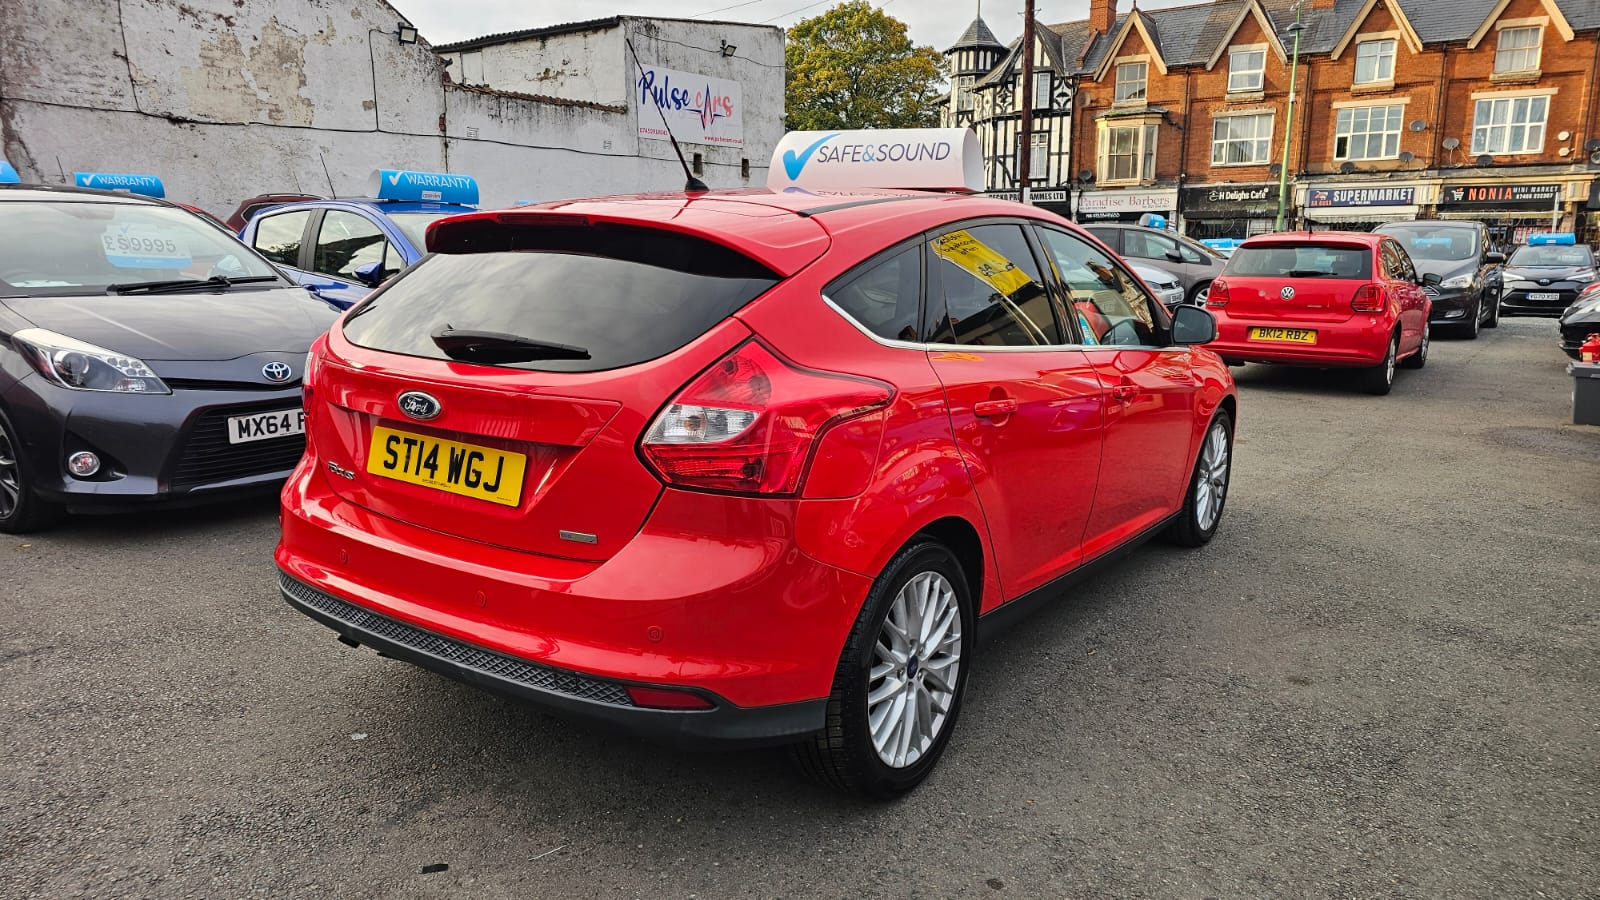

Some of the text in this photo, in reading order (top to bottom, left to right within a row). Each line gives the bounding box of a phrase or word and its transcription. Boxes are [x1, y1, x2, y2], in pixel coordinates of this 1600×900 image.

[638, 70, 690, 110] Pulse
[817, 142, 951, 164] SAFE&SOUND
[97, 175, 156, 187] WARRANTY
[404, 173, 471, 189] WARRANTY
[1053, 192, 1064, 200] LTD
[1080, 194, 1170, 207] Paradise Barbers
[1333, 188, 1413, 202] SUPERMARKET
[1468, 187, 1513, 201] NONIA
[1530, 185, 1559, 193] MARKET
[1258, 328, 1309, 341] BK12 RBZ
[237, 413, 292, 439] MX64
[383, 434, 505, 493] ST14 WGJ
